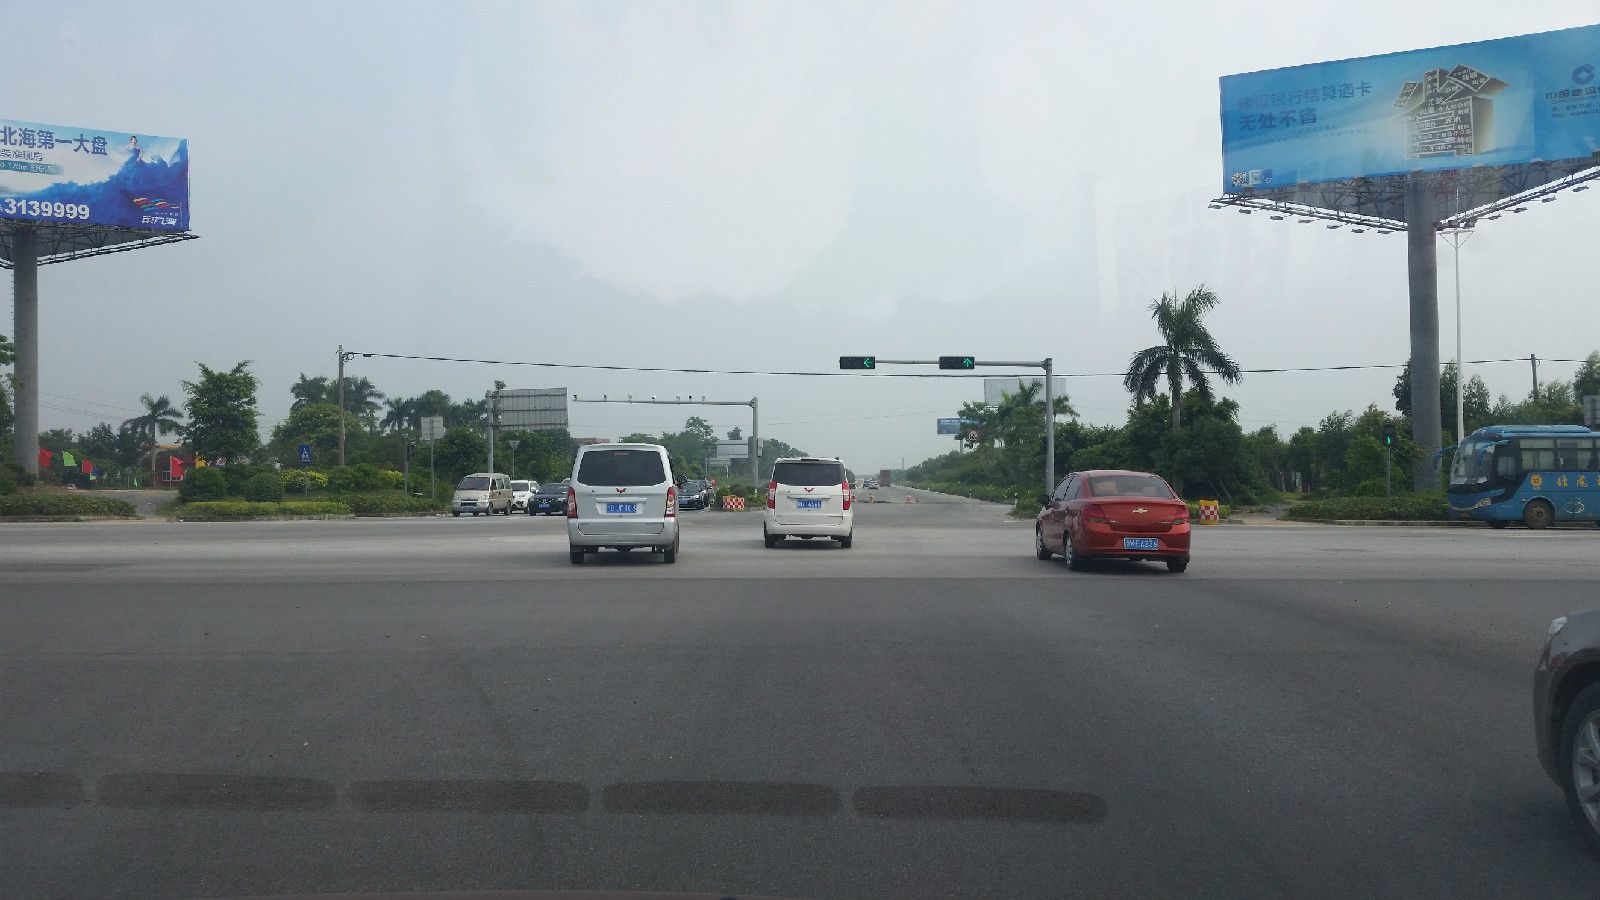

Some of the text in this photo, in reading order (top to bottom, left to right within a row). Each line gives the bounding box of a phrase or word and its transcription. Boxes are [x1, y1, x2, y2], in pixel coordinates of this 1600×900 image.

[1237, 81, 1373, 110] 建设银行结算通卡
[1546, 85, 1600, 99] 中国建设
[1239, 107, 1317, 132] 无处不省
[0, 125, 107, 156] 北海第一大盘
[4, 198, 90, 220] 3139999
